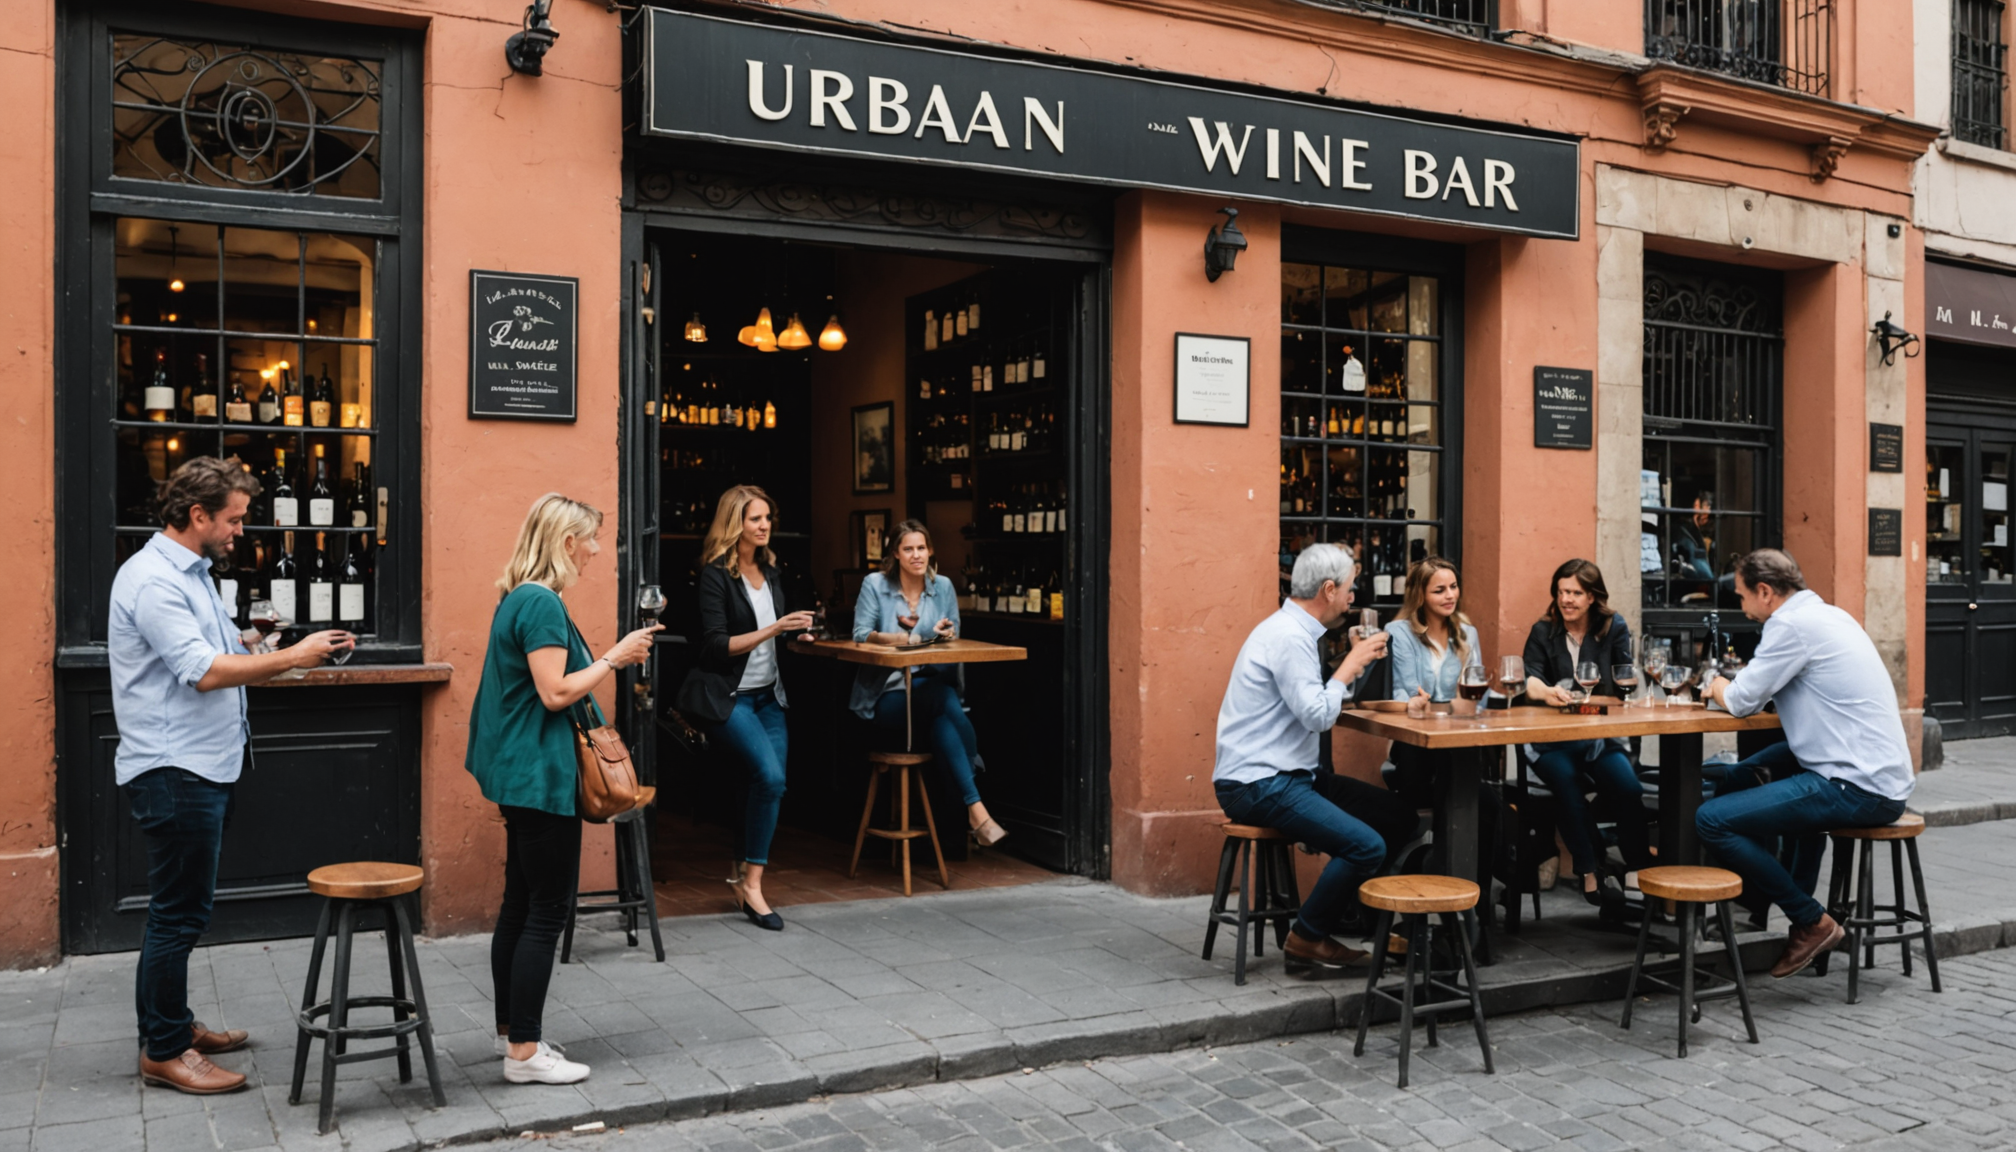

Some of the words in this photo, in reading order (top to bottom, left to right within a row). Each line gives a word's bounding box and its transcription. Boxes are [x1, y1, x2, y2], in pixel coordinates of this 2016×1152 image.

[745, 59, 1064, 154] URBAAN
[1187, 116, 1372, 191] WINE
[1404, 148, 1519, 211] BAR
